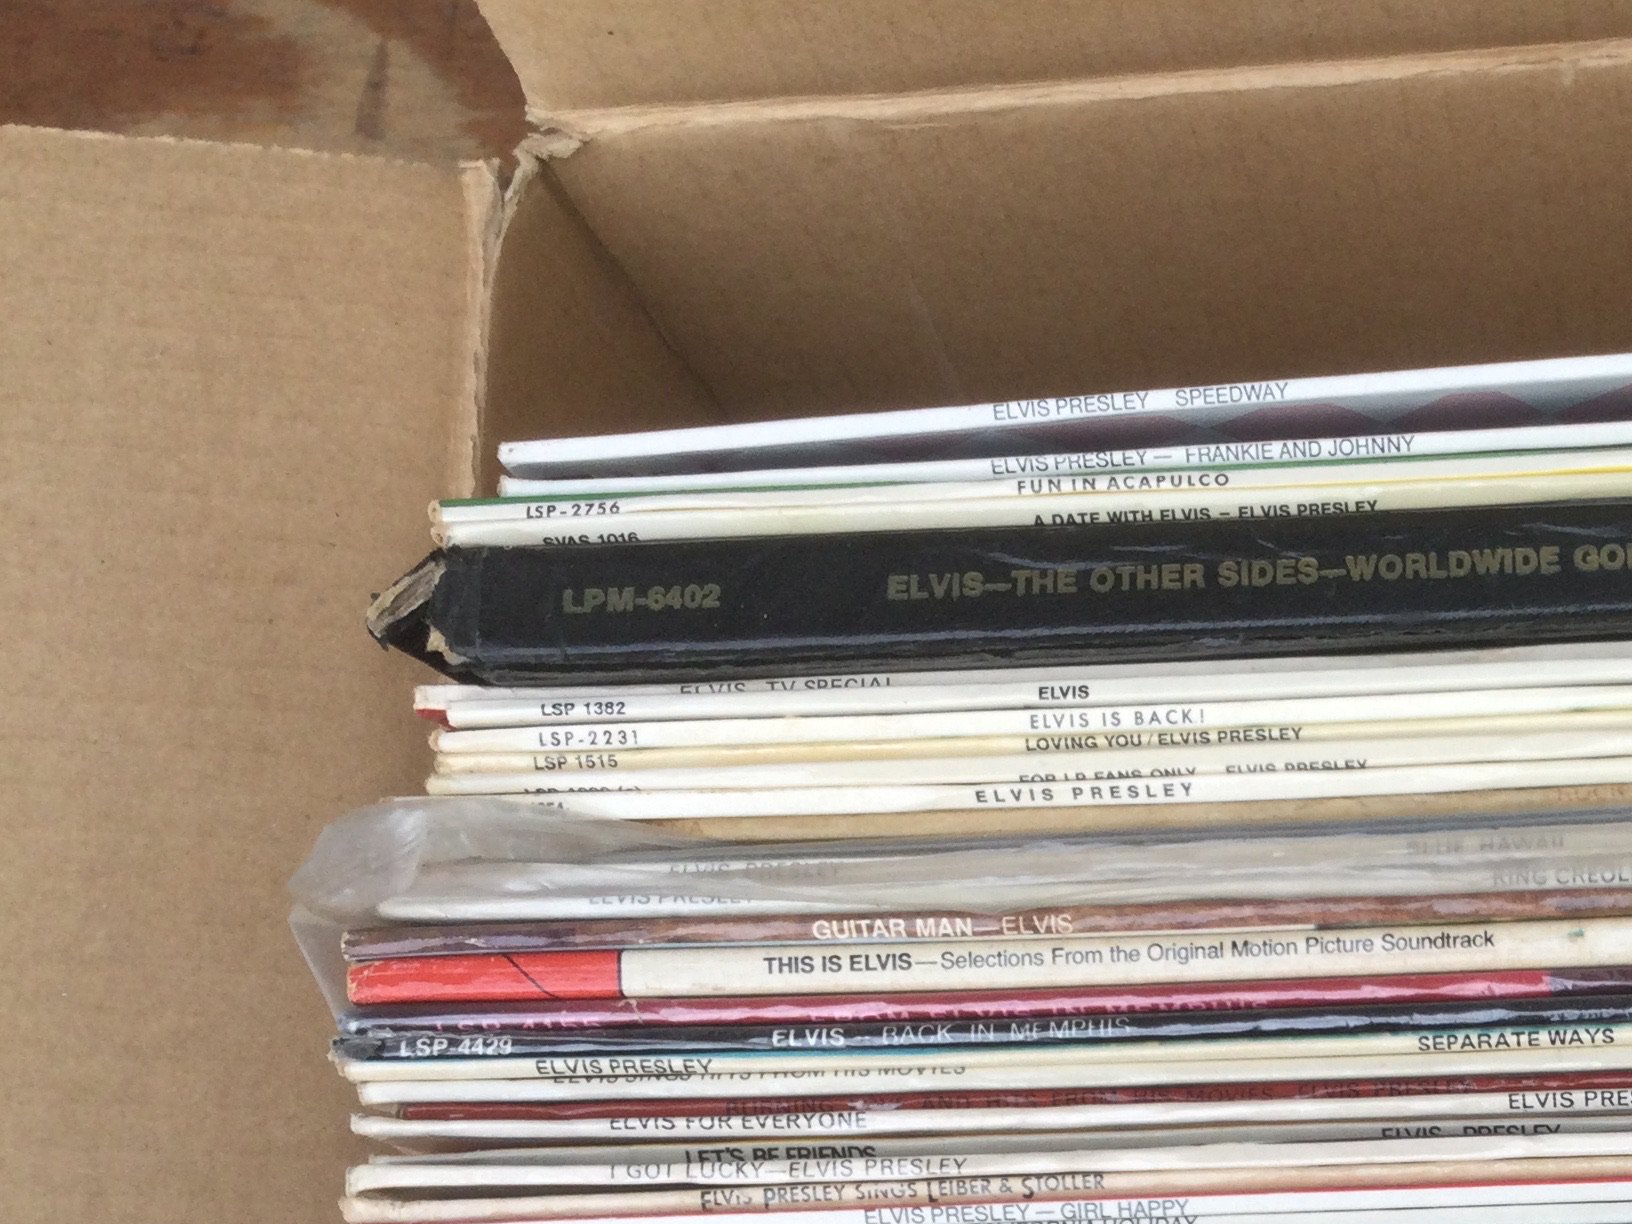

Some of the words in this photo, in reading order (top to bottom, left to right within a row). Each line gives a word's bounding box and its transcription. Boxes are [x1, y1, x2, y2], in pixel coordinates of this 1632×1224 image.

[993, 402, 1051, 421] ELVIS
[1056, 392, 1148, 416] PRESLEY
[1175, 382, 1288, 406] SPEEDWAY
[1278, 441, 1322, 460] AND
[1327, 436, 1415, 458] JOHNNY
[1017, 478, 1062, 495] FUN
[1070, 477, 1095, 492] IN
[1107, 473, 1230, 491] ACAPULCO
[526, 501, 620, 519] LSP-2756
[1089, 563, 1205, 592] OTHER
[561, 584, 721, 614] LPM-6402
[1038, 685, 1089, 700] ELVIS
[1030, 712, 1090, 730] ELVIS
[1101, 711, 1121, 728] IS
[1133, 708, 1206, 726] BACK!
[1026, 734, 1098, 752] LOVING
[1217, 726, 1303, 744] PRESLEY
[1051, 946, 1103, 966] From
[1110, 945, 1140, 964] the
[1146, 942, 1225, 964] Original
[1232, 937, 1299, 957] Motion
[1305, 935, 1374, 955] Picture
[1381, 931, 1495, 951] Soundtrack
[763, 957, 816, 974] THIS
[823, 956, 843, 972] IS
[1418, 1030, 1541, 1051] SEPARATE
[1548, 1028, 1615, 1046] WAYS
[1508, 1092, 1575, 1110] ELVIS
